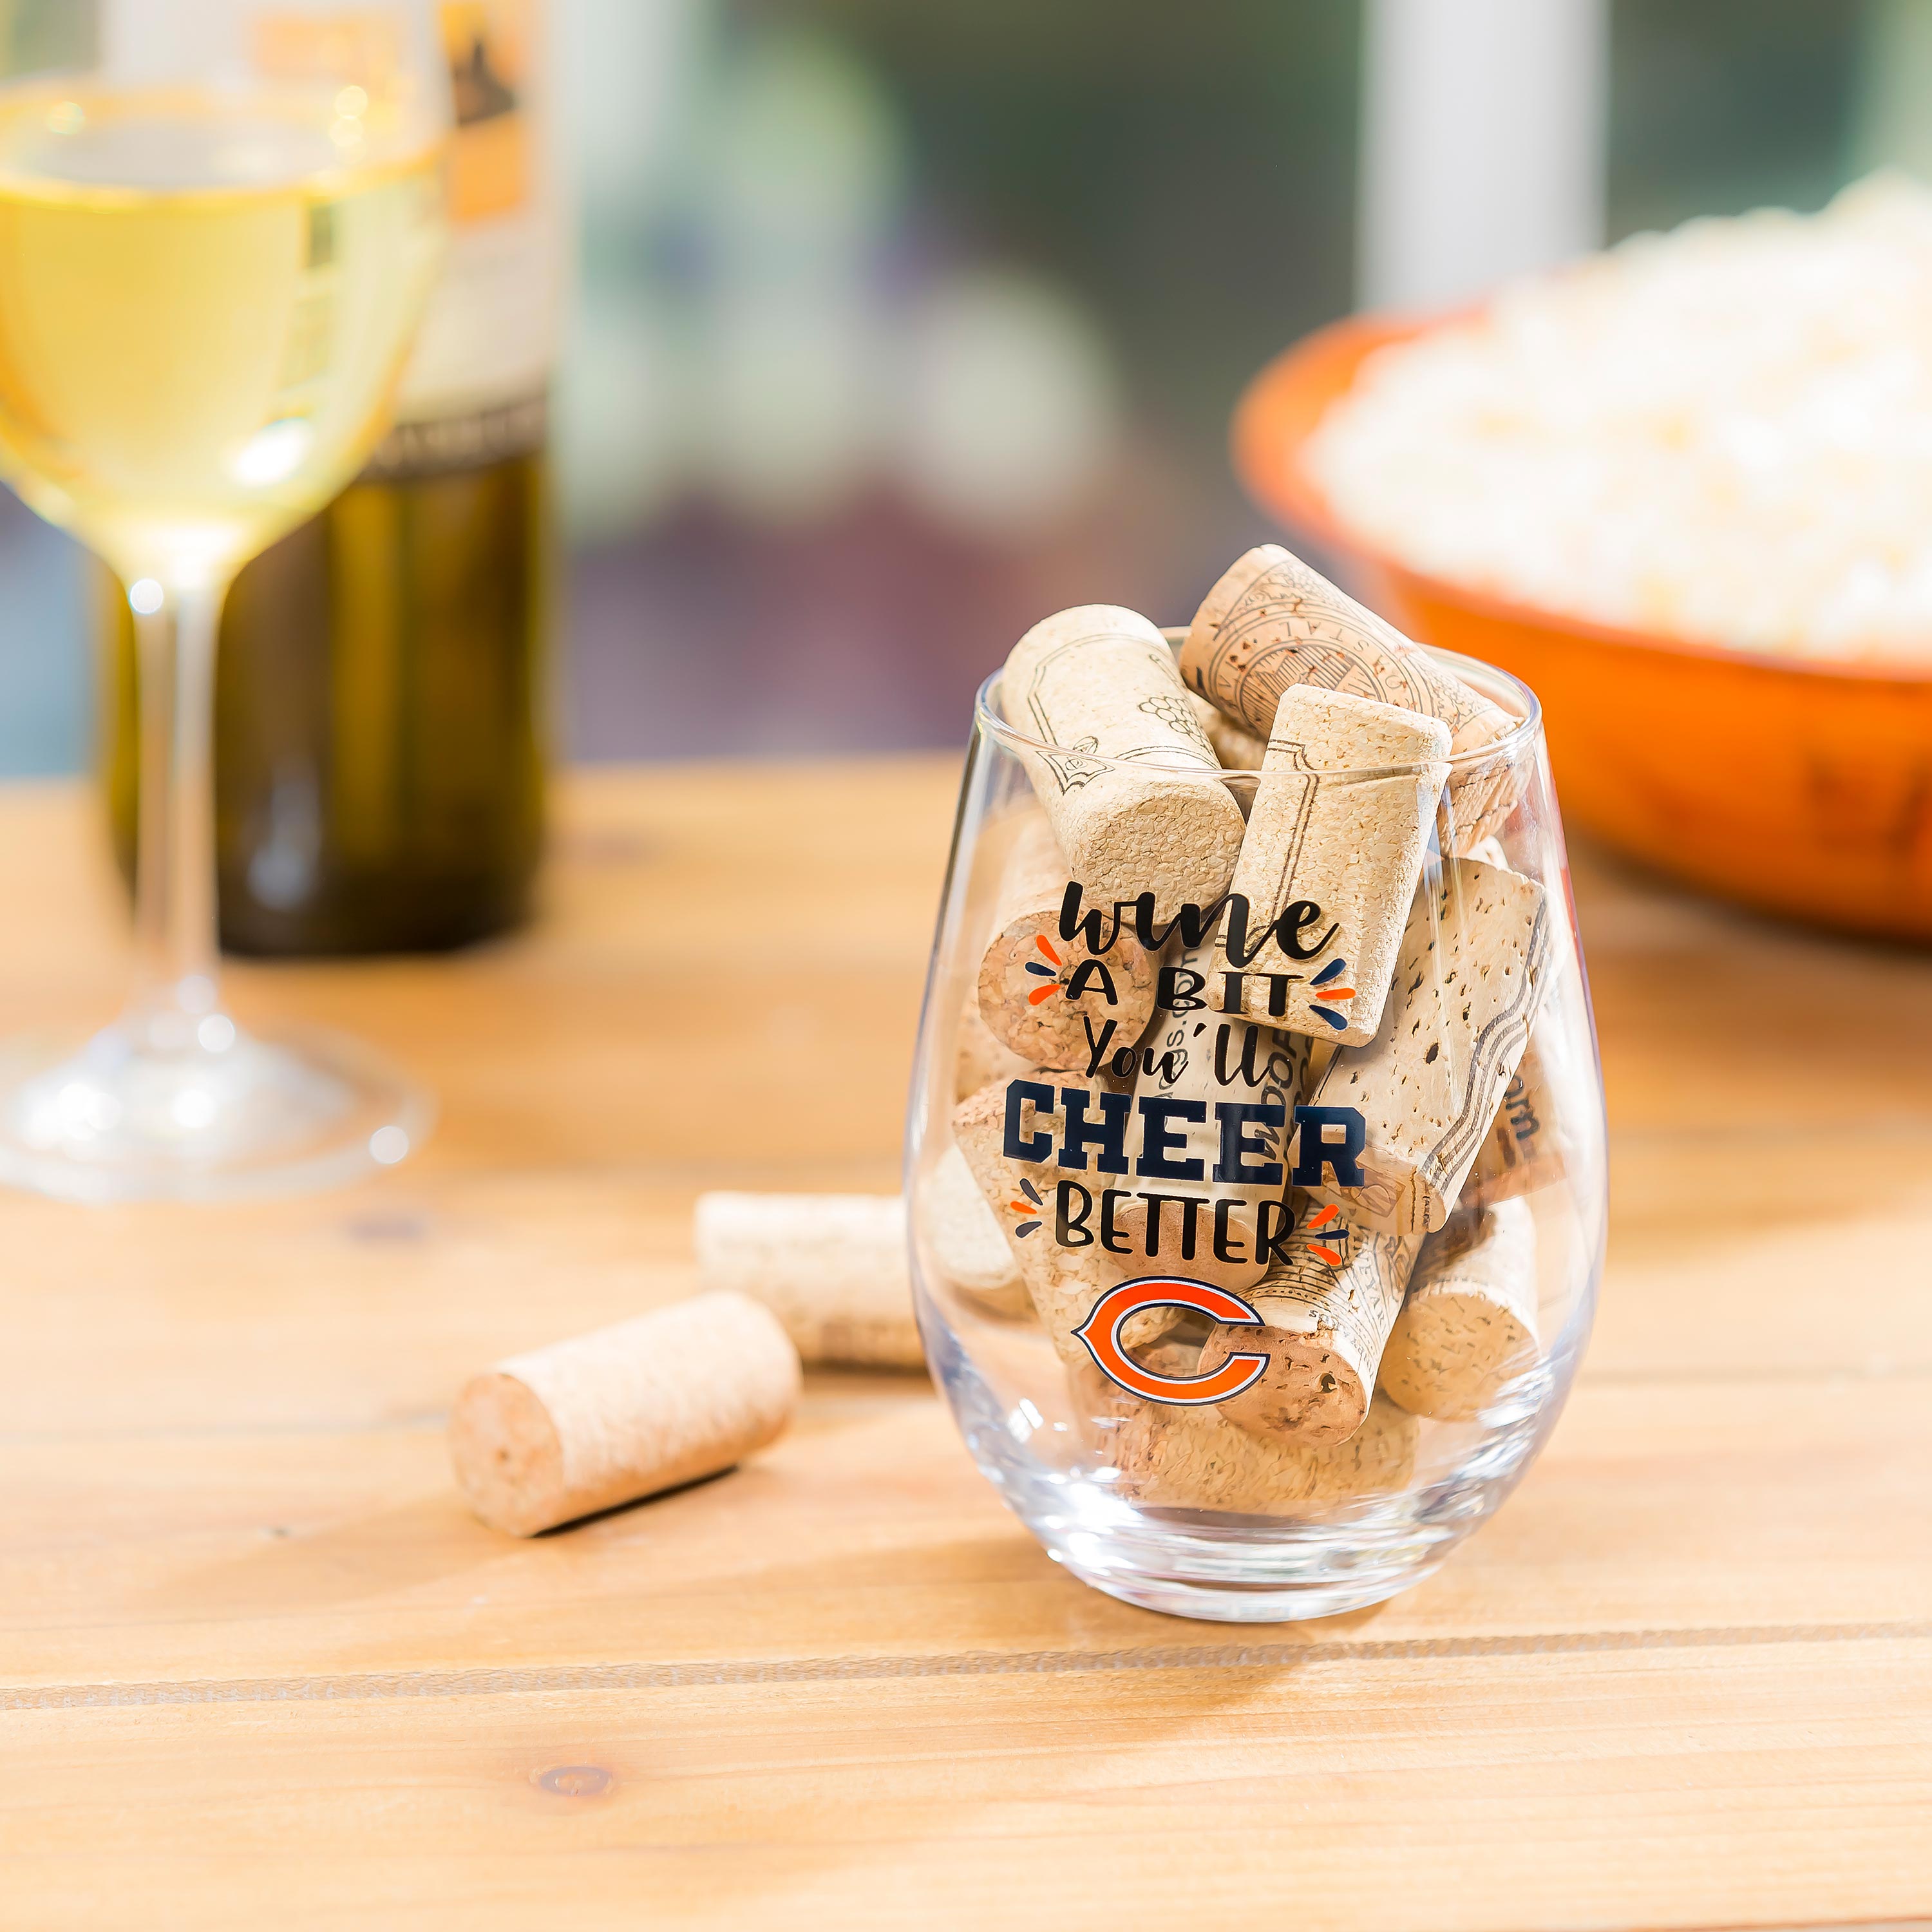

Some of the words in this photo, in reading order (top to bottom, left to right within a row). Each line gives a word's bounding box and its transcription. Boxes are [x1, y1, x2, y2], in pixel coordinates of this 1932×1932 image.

[1066, 959, 1118, 1005] A
[1157, 966, 1304, 1017] BIT
[1083, 1015, 1273, 1088] You'll
[1003, 1079, 1365, 1187] CHEER
[1056, 1180, 1294, 1266] BETTER
[1071, 1275, 1270, 1406] C
